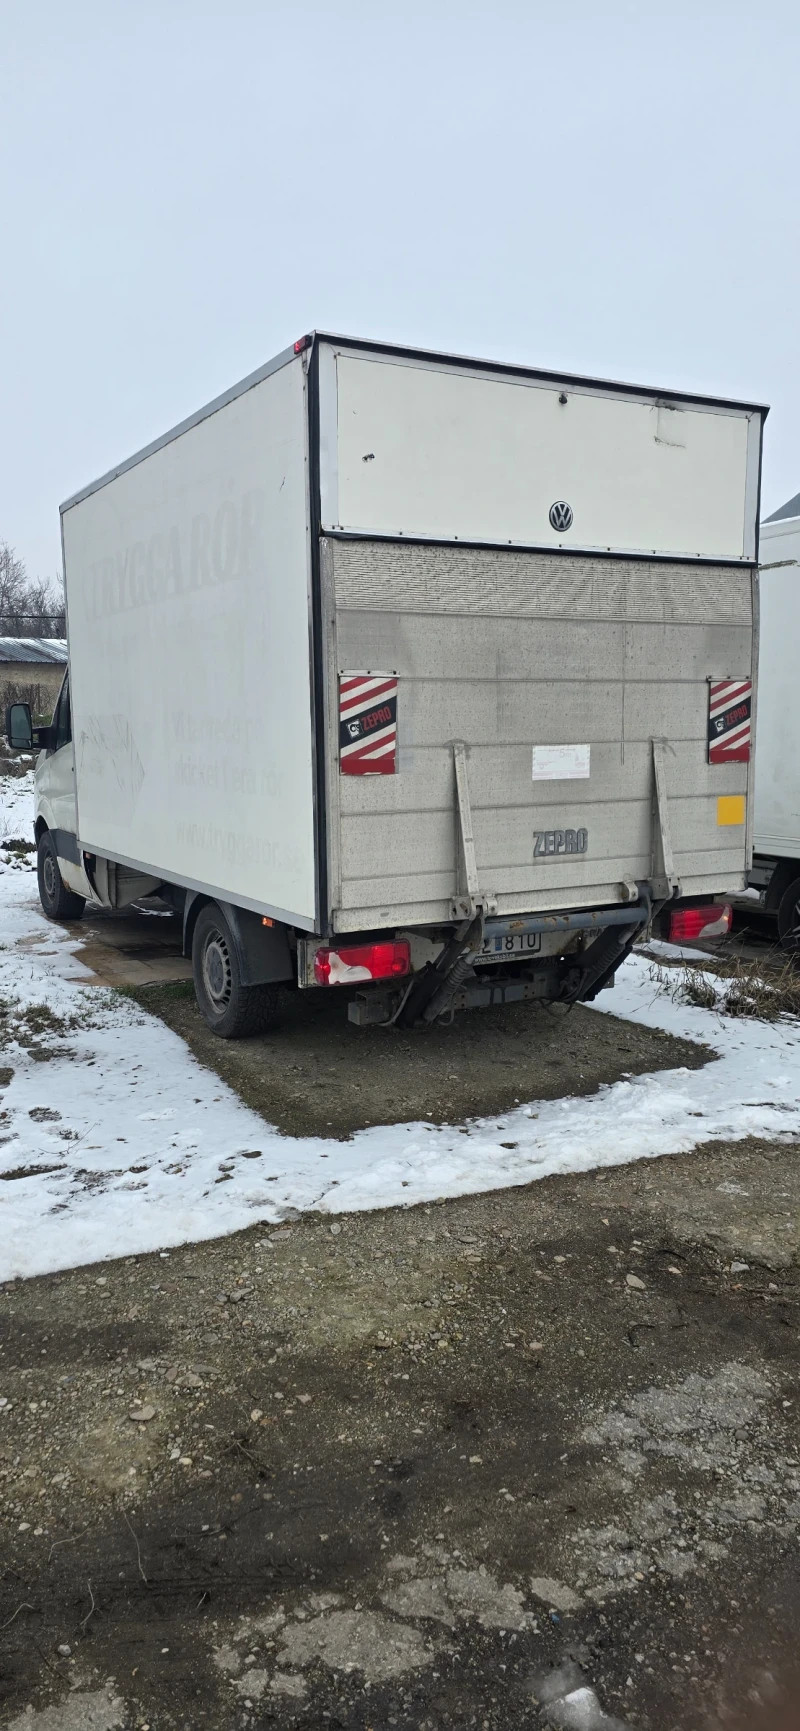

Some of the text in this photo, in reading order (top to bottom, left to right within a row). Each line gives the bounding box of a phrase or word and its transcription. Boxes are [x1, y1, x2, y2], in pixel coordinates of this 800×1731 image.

[361, 706, 392, 731] ZEPRO
[725, 705, 748, 725] ZEPRO
[533, 828, 588, 857] ZEPRO
[505, 933, 536, 950] 810
